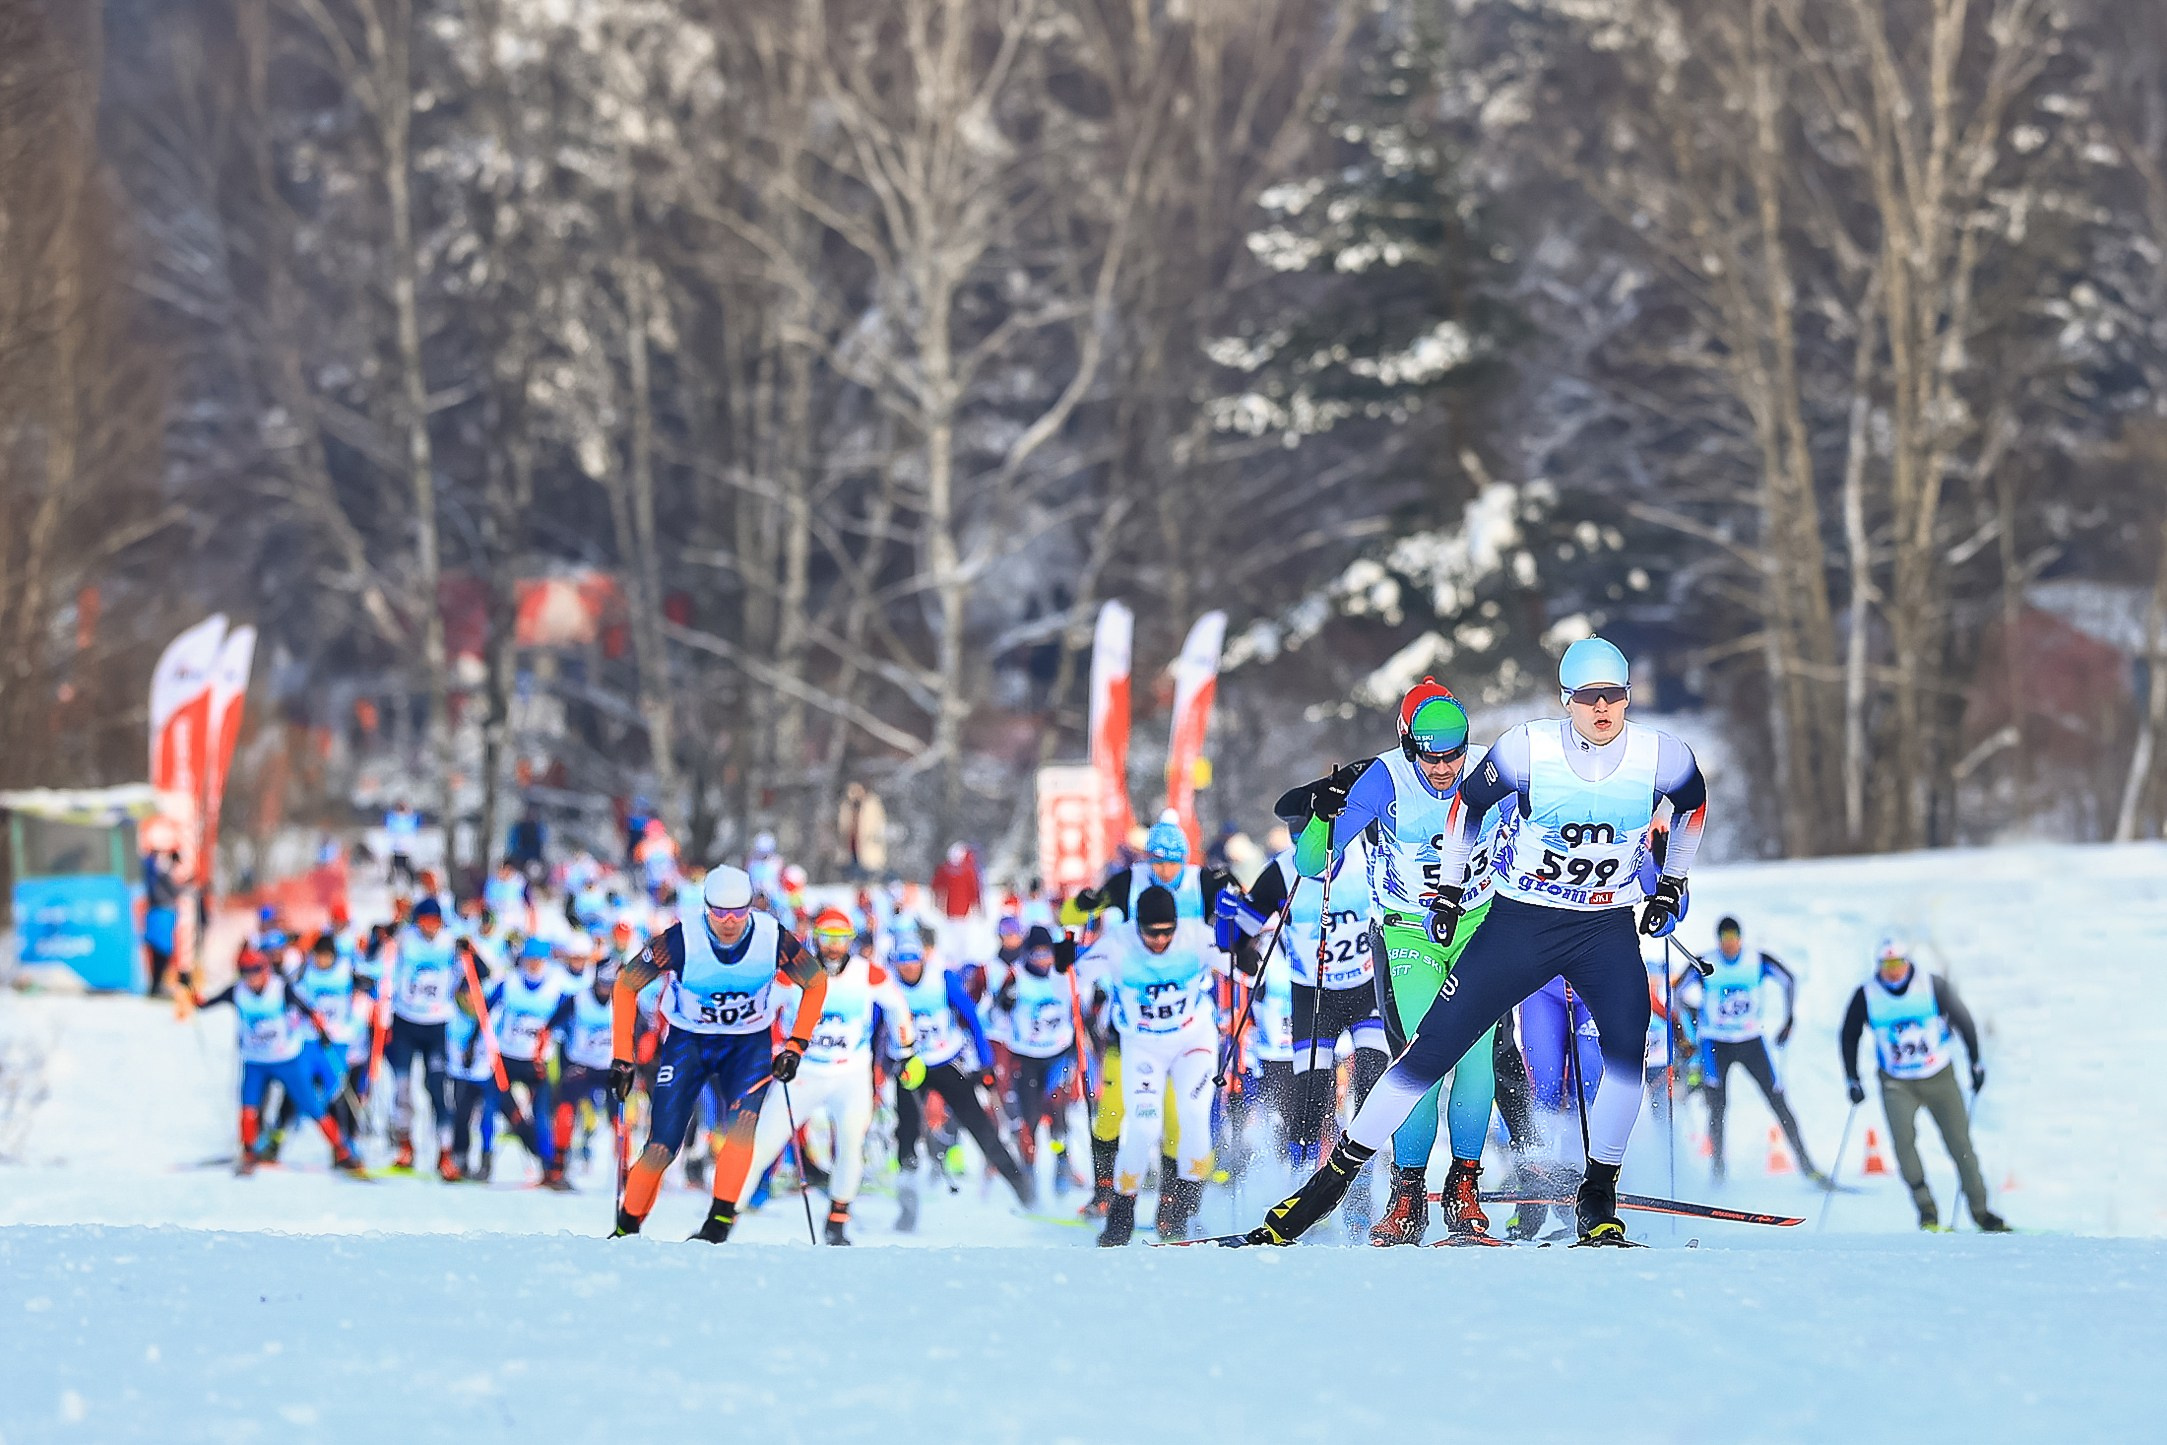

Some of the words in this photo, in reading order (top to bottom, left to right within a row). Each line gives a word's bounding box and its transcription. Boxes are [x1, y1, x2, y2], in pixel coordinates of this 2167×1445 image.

[1561, 823, 1614, 848] gm
[1536, 848, 1620, 886] 599
[1518, 875, 1588, 904] grom
[1422, 955, 1442, 974] SKI
[1140, 997, 1187, 1020] 587
